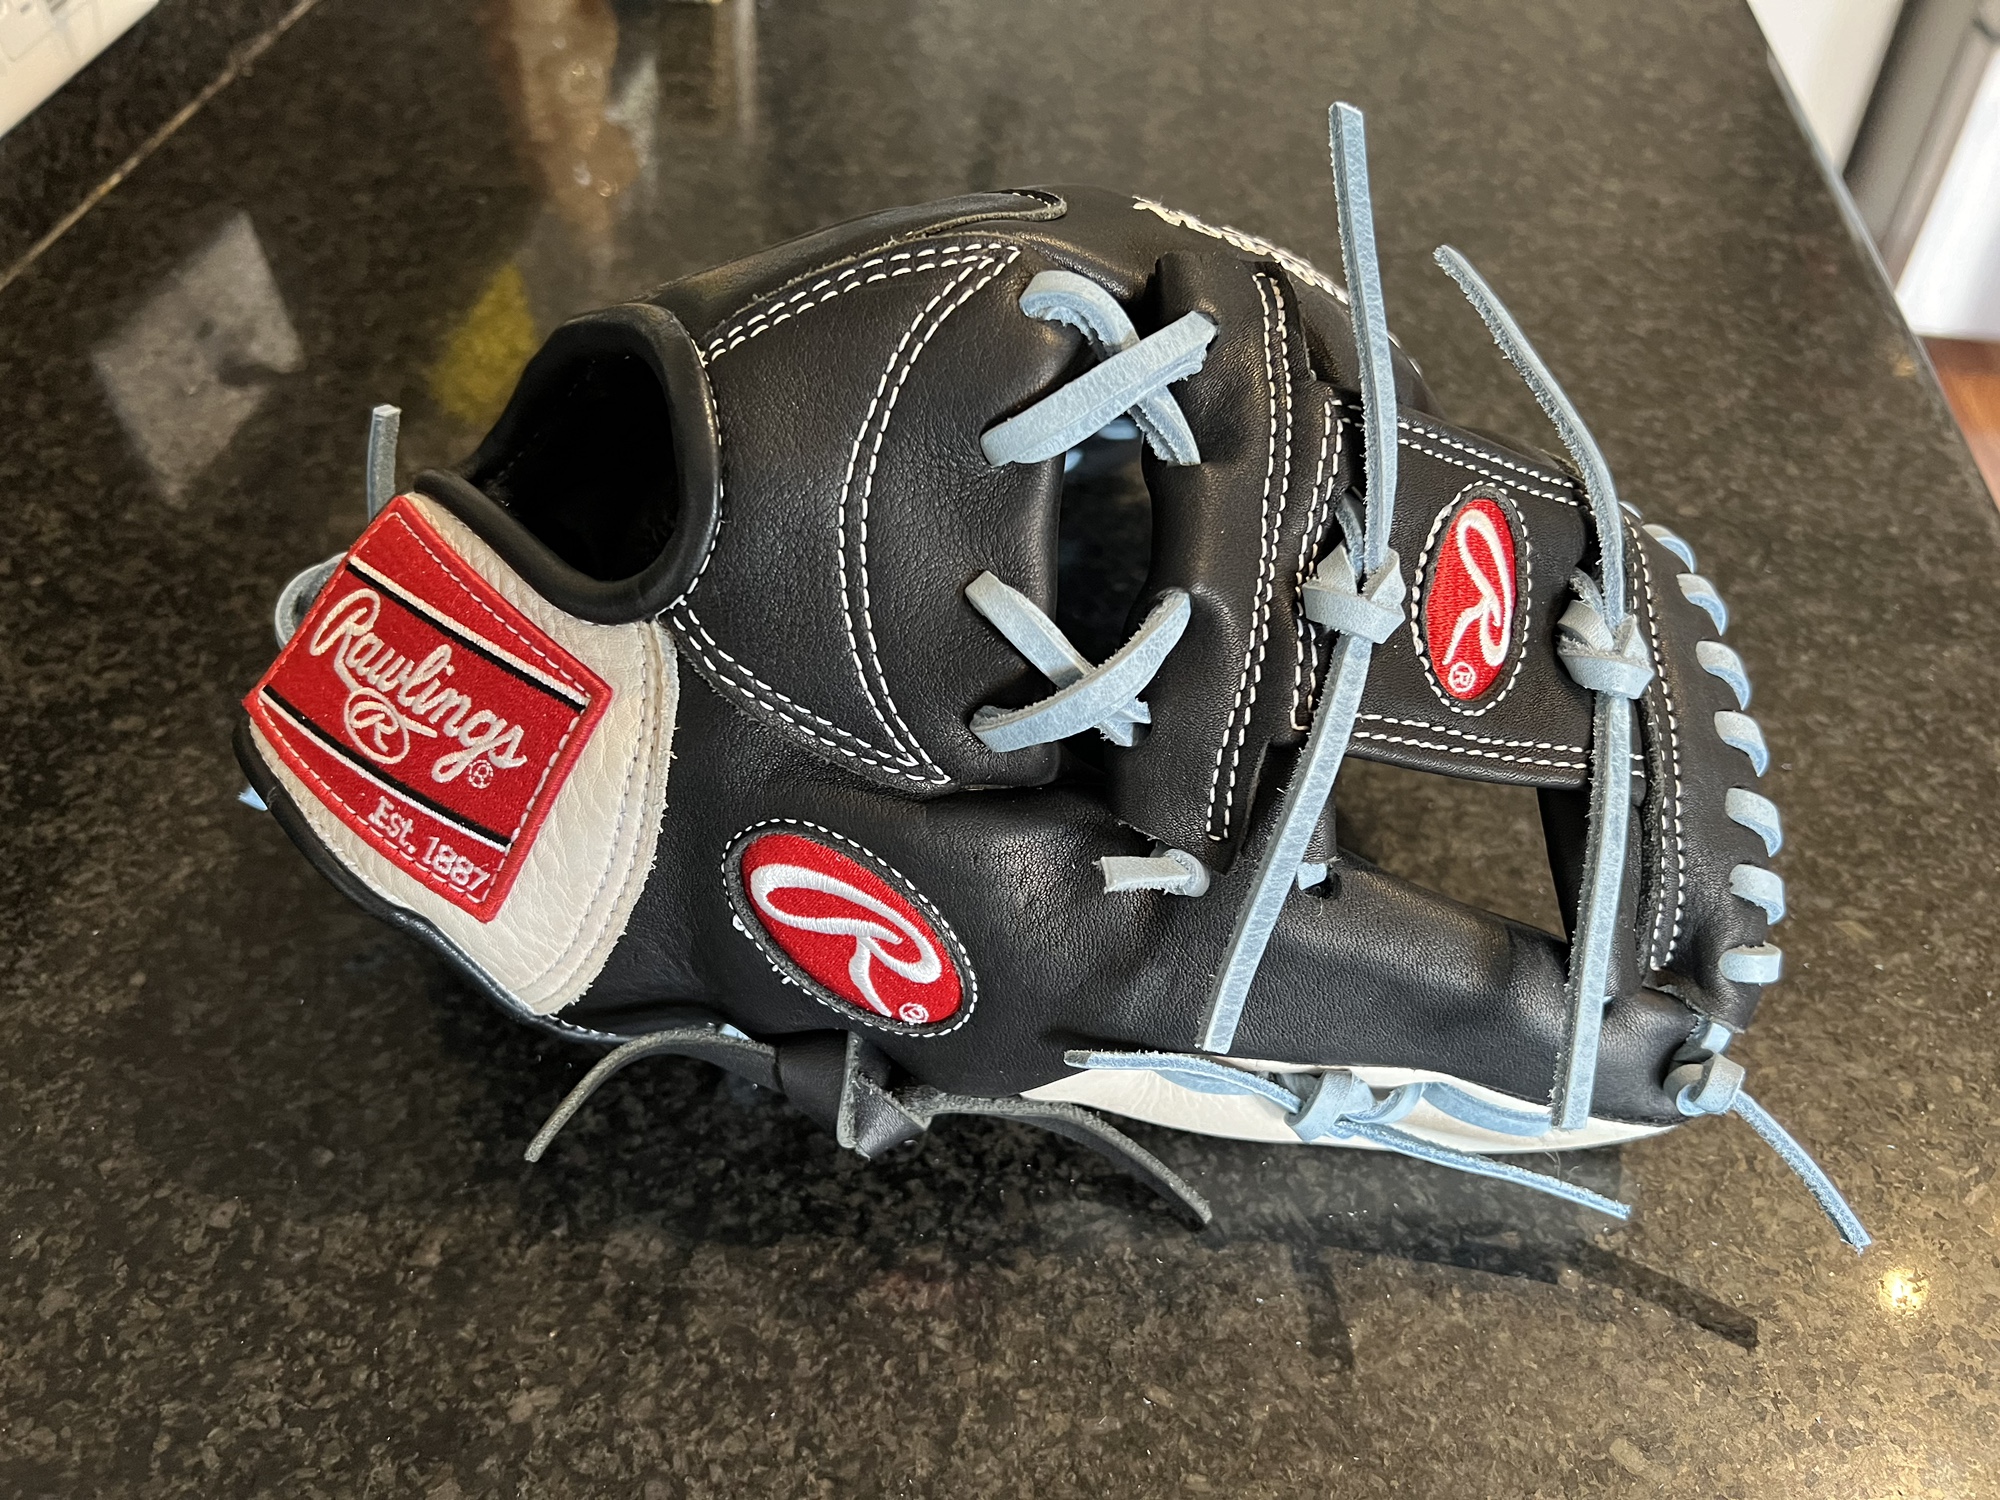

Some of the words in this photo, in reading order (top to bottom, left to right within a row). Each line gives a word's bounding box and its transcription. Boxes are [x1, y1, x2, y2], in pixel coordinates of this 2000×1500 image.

[1442, 509, 1512, 667] R
[309, 588, 528, 784] Rawlings
[367, 795, 416, 854] Est.
[421, 836, 491, 892] 1887
[750, 863, 942, 1017] R
